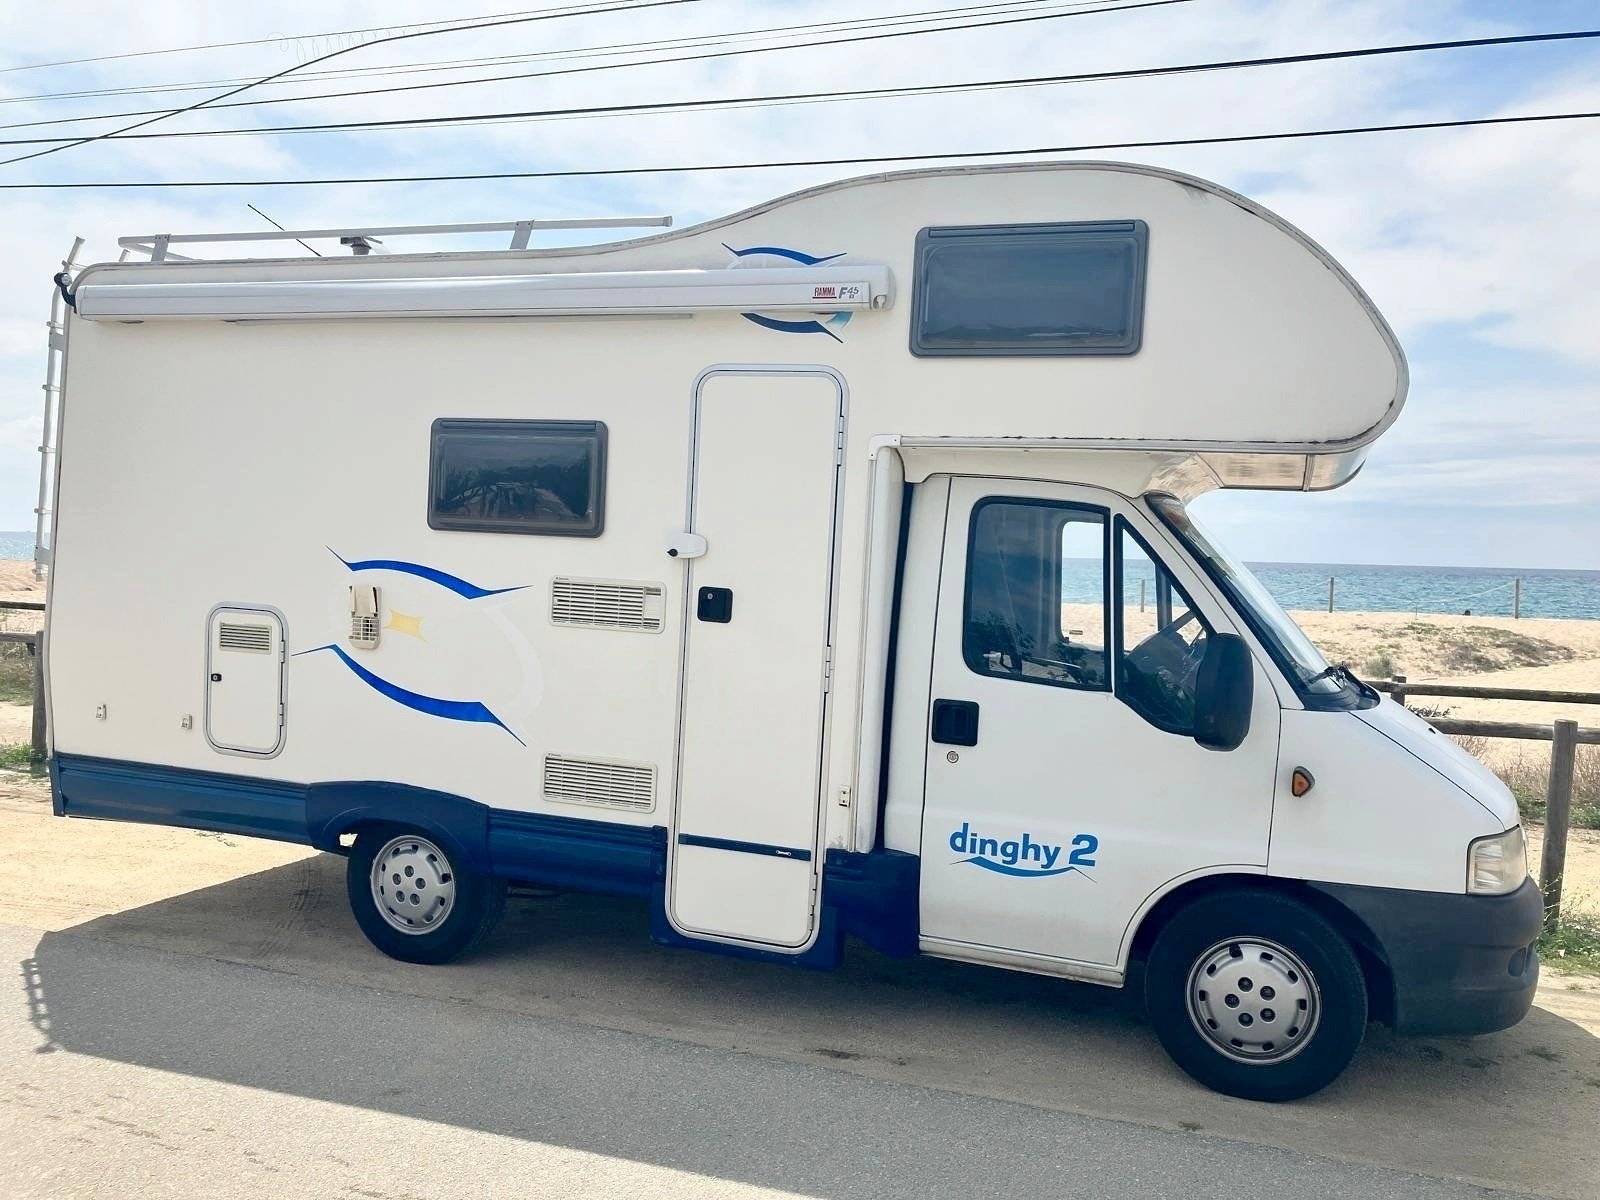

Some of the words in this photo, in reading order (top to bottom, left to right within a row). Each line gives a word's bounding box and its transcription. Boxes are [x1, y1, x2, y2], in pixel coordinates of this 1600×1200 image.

[814, 287, 836, 297] FIAMMA
[949, 822, 1062, 870] dinghy
[1068, 833, 1099, 867] 2
